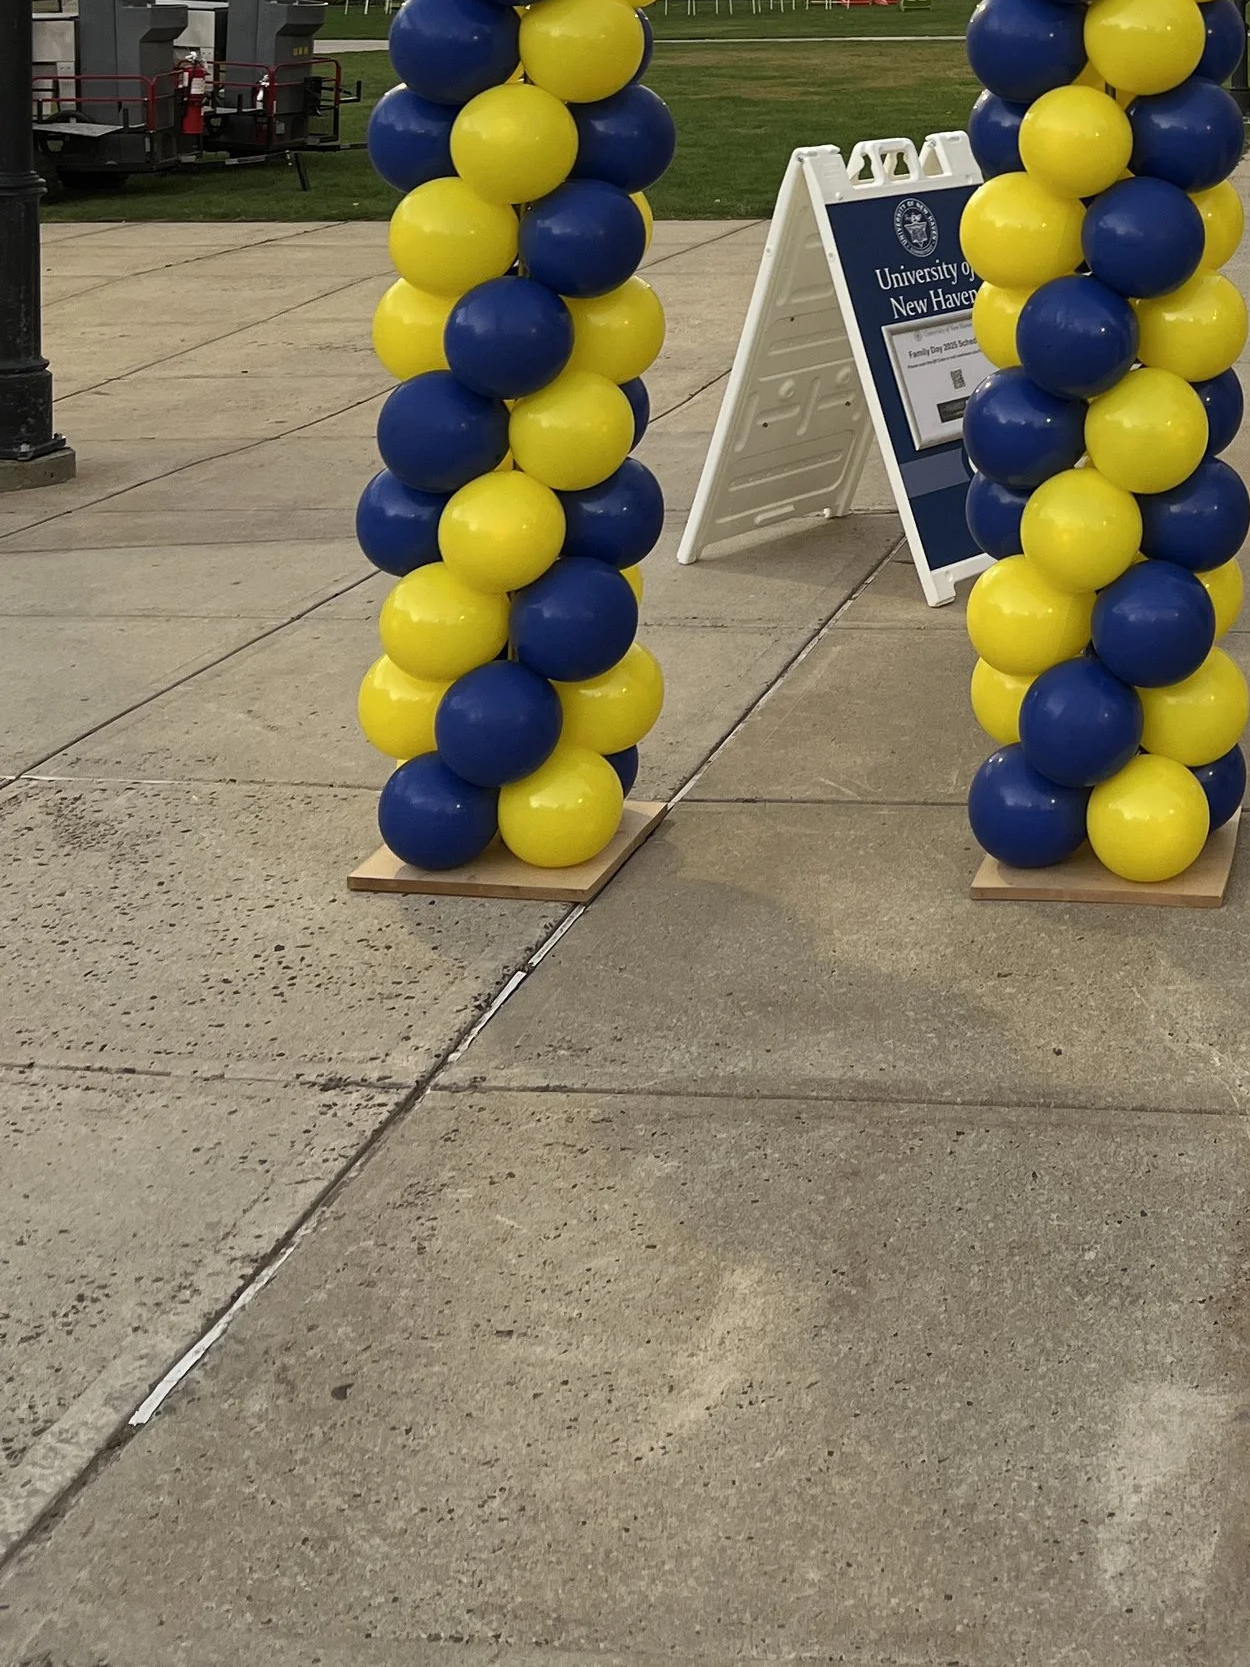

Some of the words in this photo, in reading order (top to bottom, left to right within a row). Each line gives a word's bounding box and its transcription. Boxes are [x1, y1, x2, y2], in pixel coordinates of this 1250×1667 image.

[875, 259, 958, 290] University
[890, 296, 928, 319] New
[908, 348, 930, 359] Family
[930, 345, 943, 355] Day
[943, 341, 958, 351] 2025
